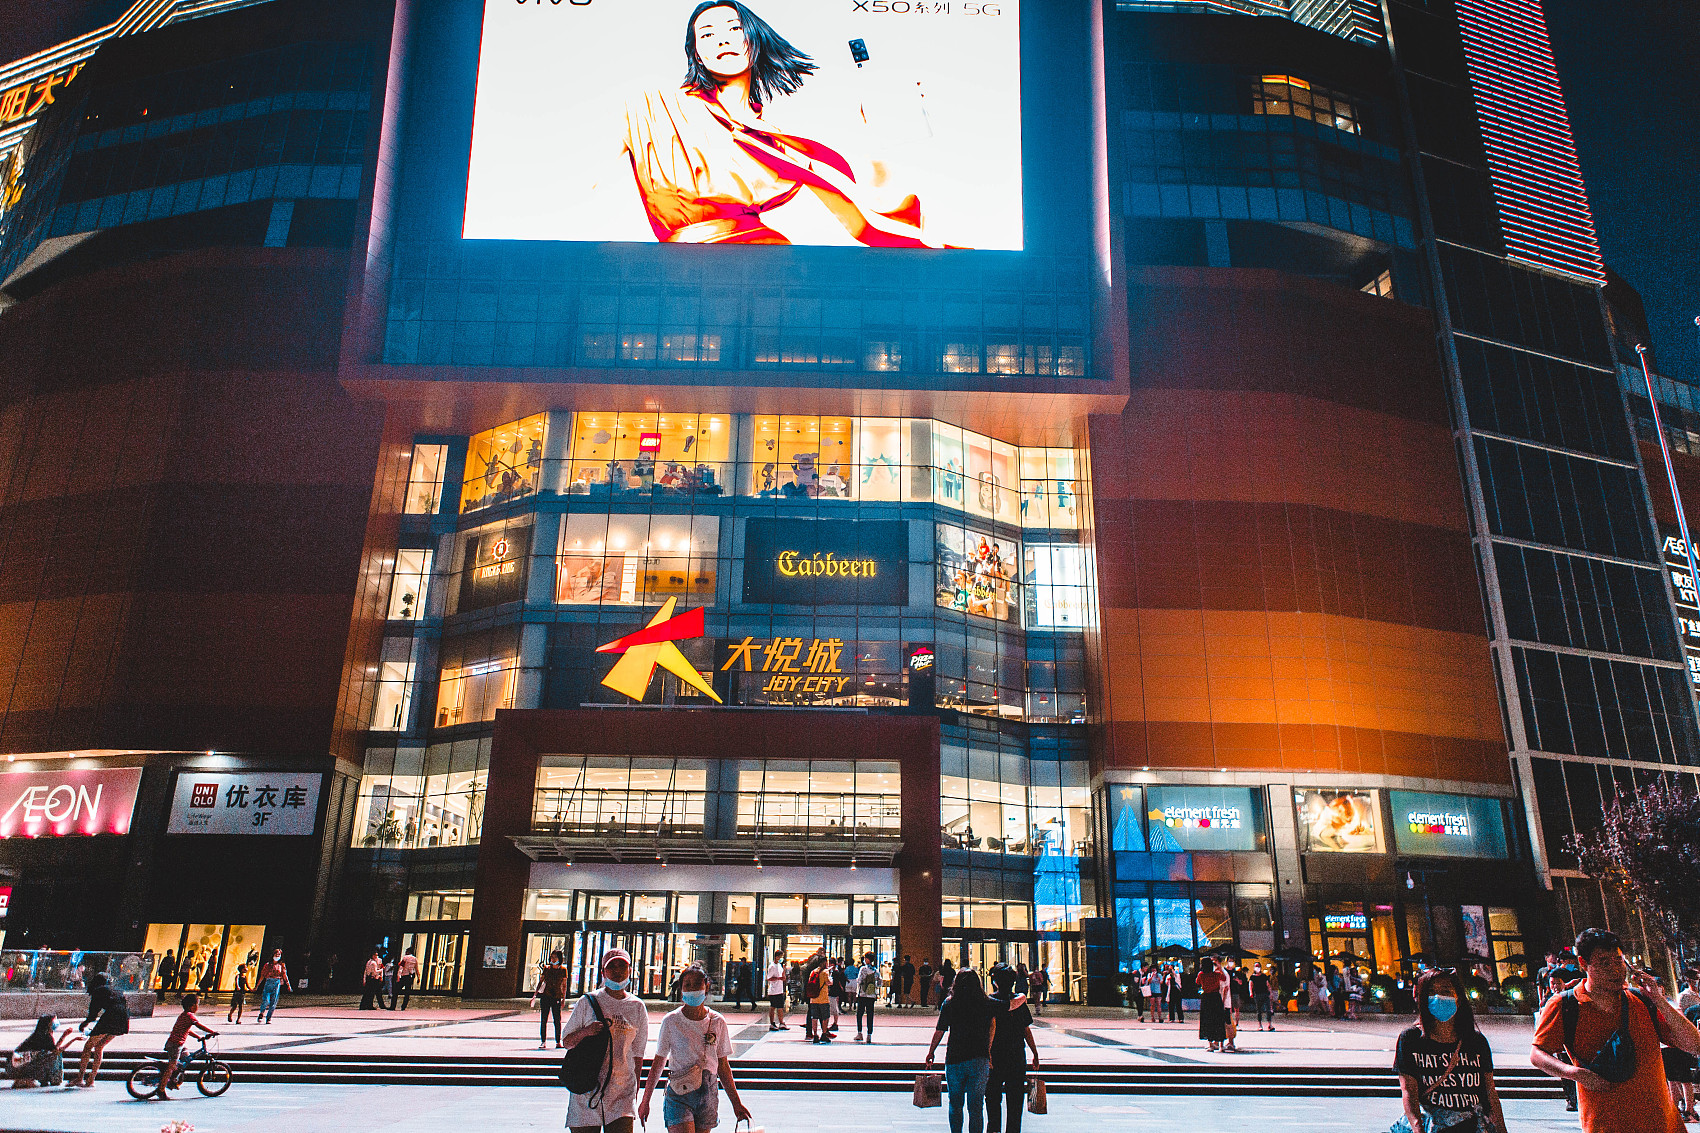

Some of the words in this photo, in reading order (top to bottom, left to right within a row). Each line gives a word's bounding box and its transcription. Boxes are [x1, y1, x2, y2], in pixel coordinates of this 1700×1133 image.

[964, 3, 1000, 16] 5G
[0, 62, 86, 122] 阳大
[778, 550, 876, 577] Cabbeen
[721, 637, 844, 673] 大悦城
[910, 655, 934, 666] Pizza
[914, 660, 932, 669] Hut
[763, 676, 803, 692] JOY
[802, 677, 850, 692] CITY
[195, 786, 214, 795] UNI
[225, 784, 308, 809] 优衣库
[193, 796, 213, 806] QLO
[252, 812, 272, 826] 3F
[1165, 806, 1211, 819] element
[1211, 806, 1240, 819] fresh
[1408, 811, 1445, 825] element
[1444, 812, 1467, 826] fresh
[1412, 1053, 1449, 1068] THAT'S
[1458, 1072, 1480, 1087] YOU
[1428, 1091, 1480, 1108] EAUTIFU
